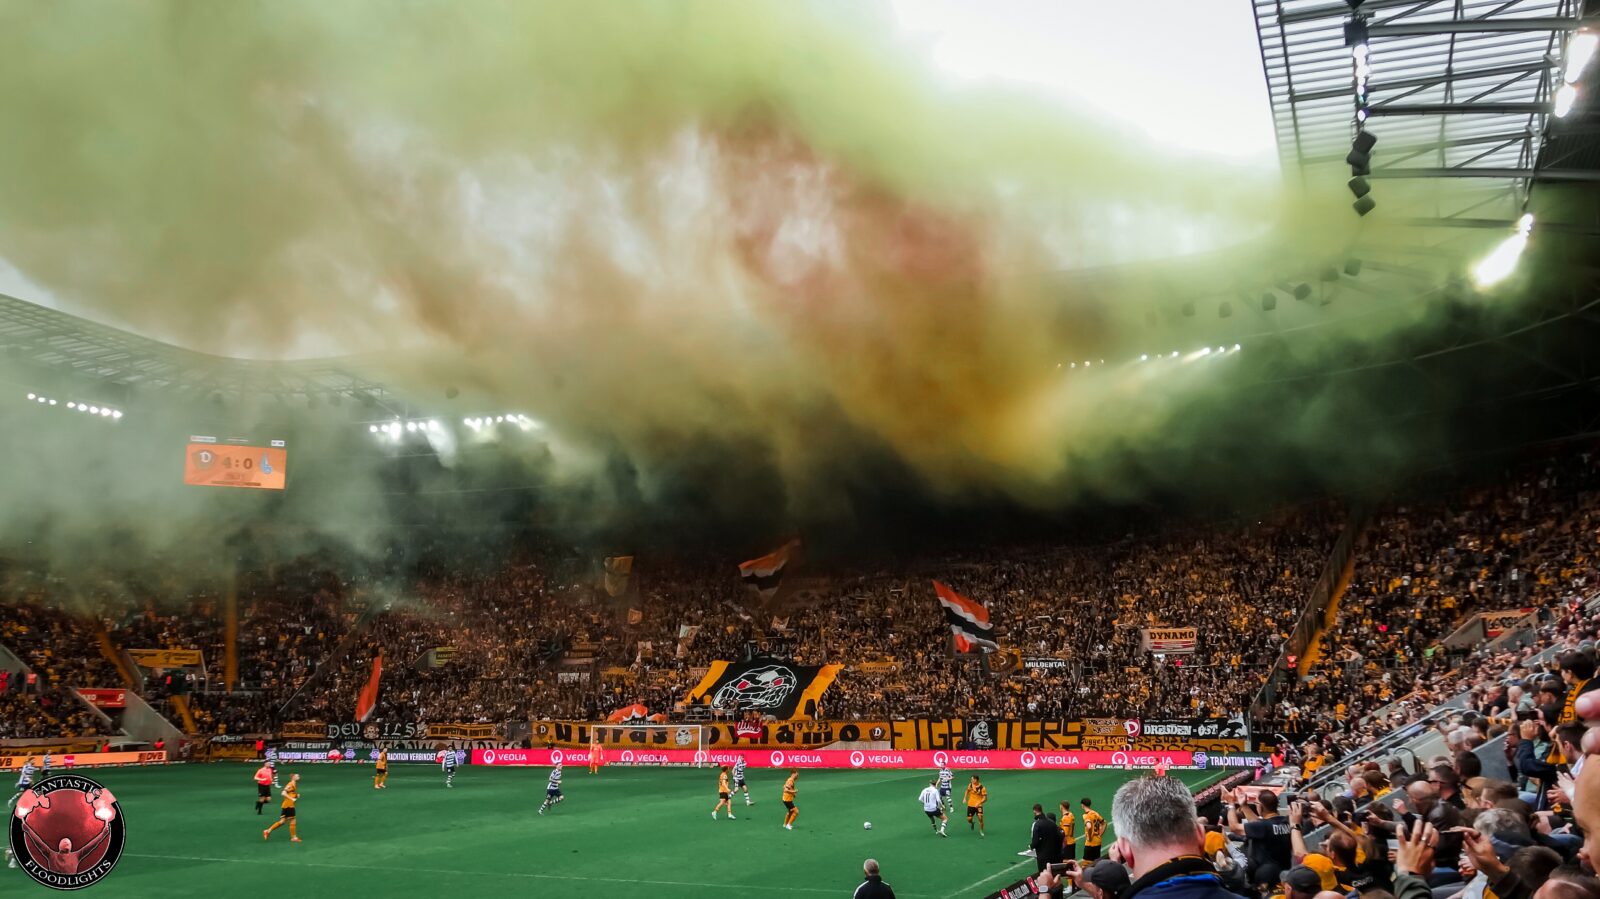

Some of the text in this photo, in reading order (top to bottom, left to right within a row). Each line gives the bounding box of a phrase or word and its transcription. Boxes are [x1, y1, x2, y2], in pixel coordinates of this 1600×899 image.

[1150, 630, 1195, 640] DYNAMO
[1025, 660, 1067, 669] MULDENTAL
[791, 722, 803, 731] 19
[817, 722, 833, 731] 53
[1143, 724, 1192, 736] DRESDEN
[146, 751, 164, 760] DVB
[387, 752, 436, 760] RADITION VERBINDET
[637, 754, 669, 762] VEOLIA
[711, 755, 742, 763] VEOLIA
[788, 755, 822, 763] VEOLIA
[868, 755, 904, 763] VEOLIA
[952, 756, 989, 764] VEOLIA
[1040, 756, 1079, 764] VEOLIA
[1132, 756, 1173, 765] VEOIA
[1210, 756, 1245, 766] TRADITION
